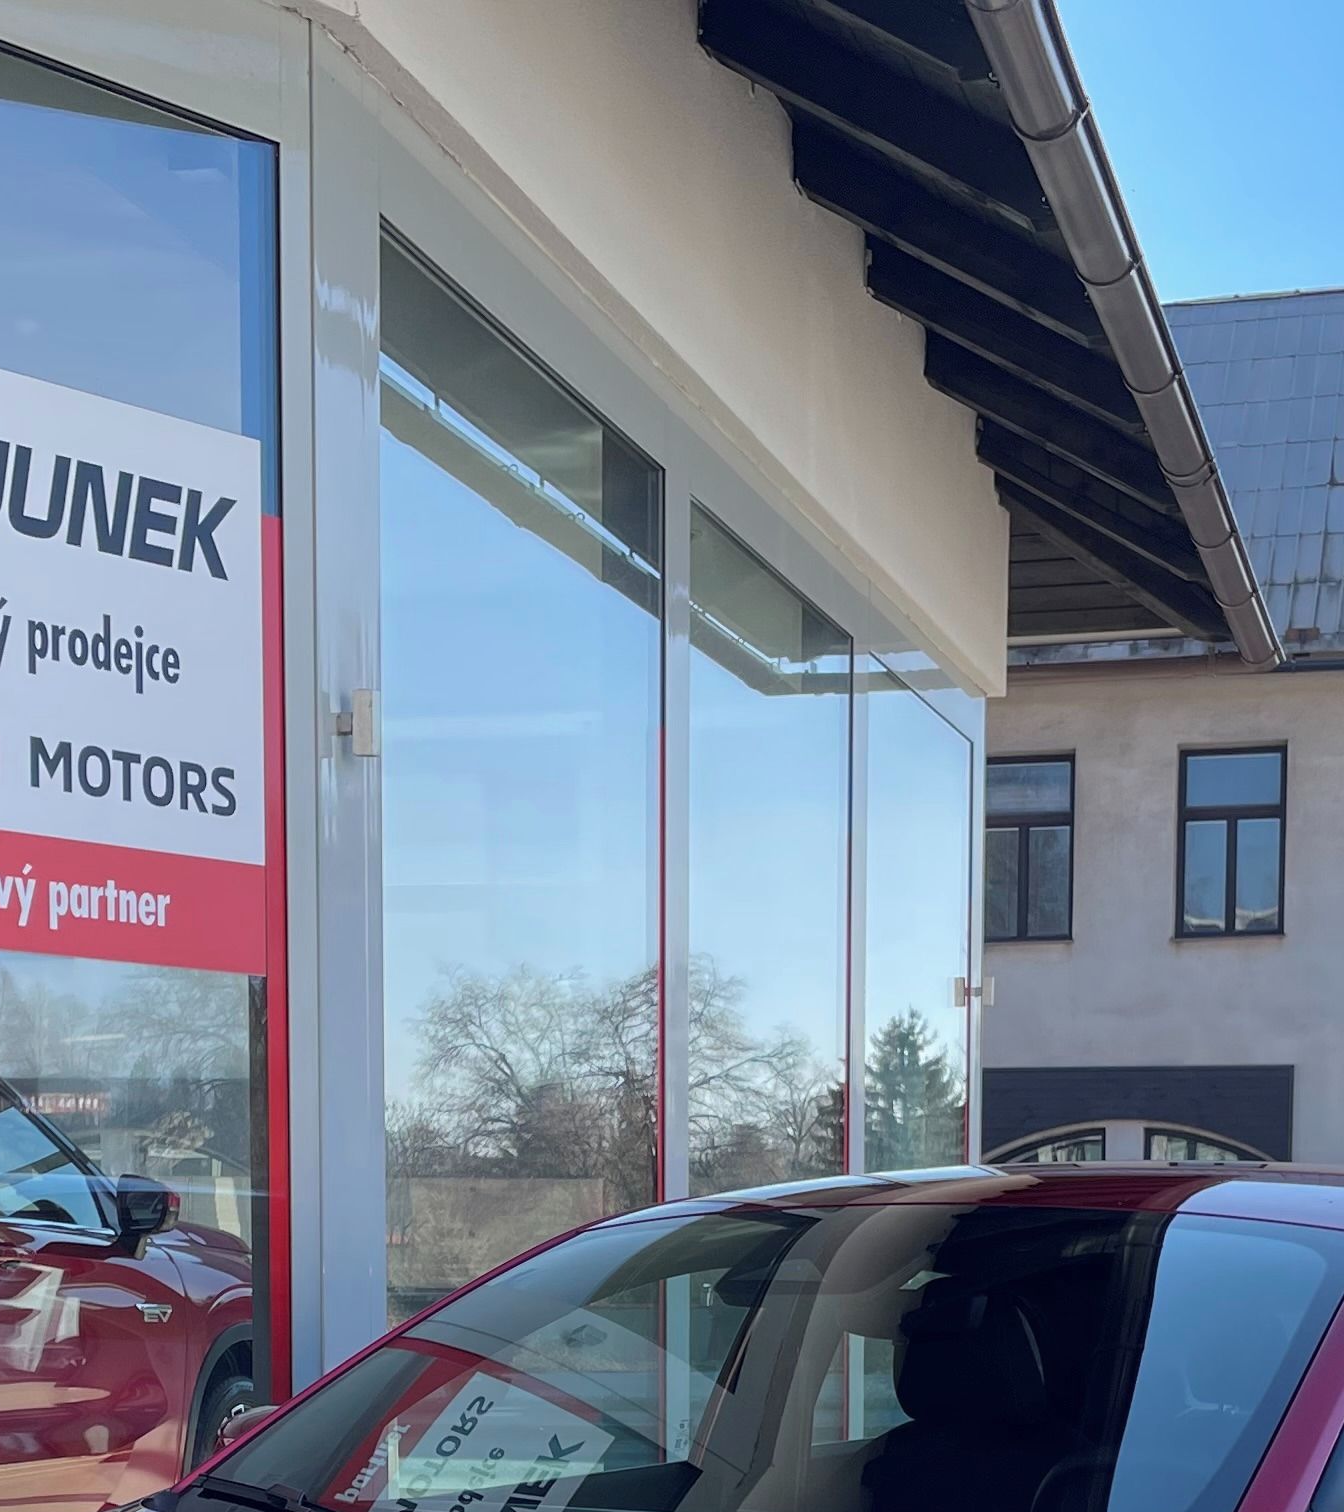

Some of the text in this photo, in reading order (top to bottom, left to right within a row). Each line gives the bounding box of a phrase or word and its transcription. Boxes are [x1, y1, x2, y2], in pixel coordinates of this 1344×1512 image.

[27, 613, 182, 694] prodejce
[29, 734, 238, 817] MOTORS
[48, 879, 171, 931] partner
